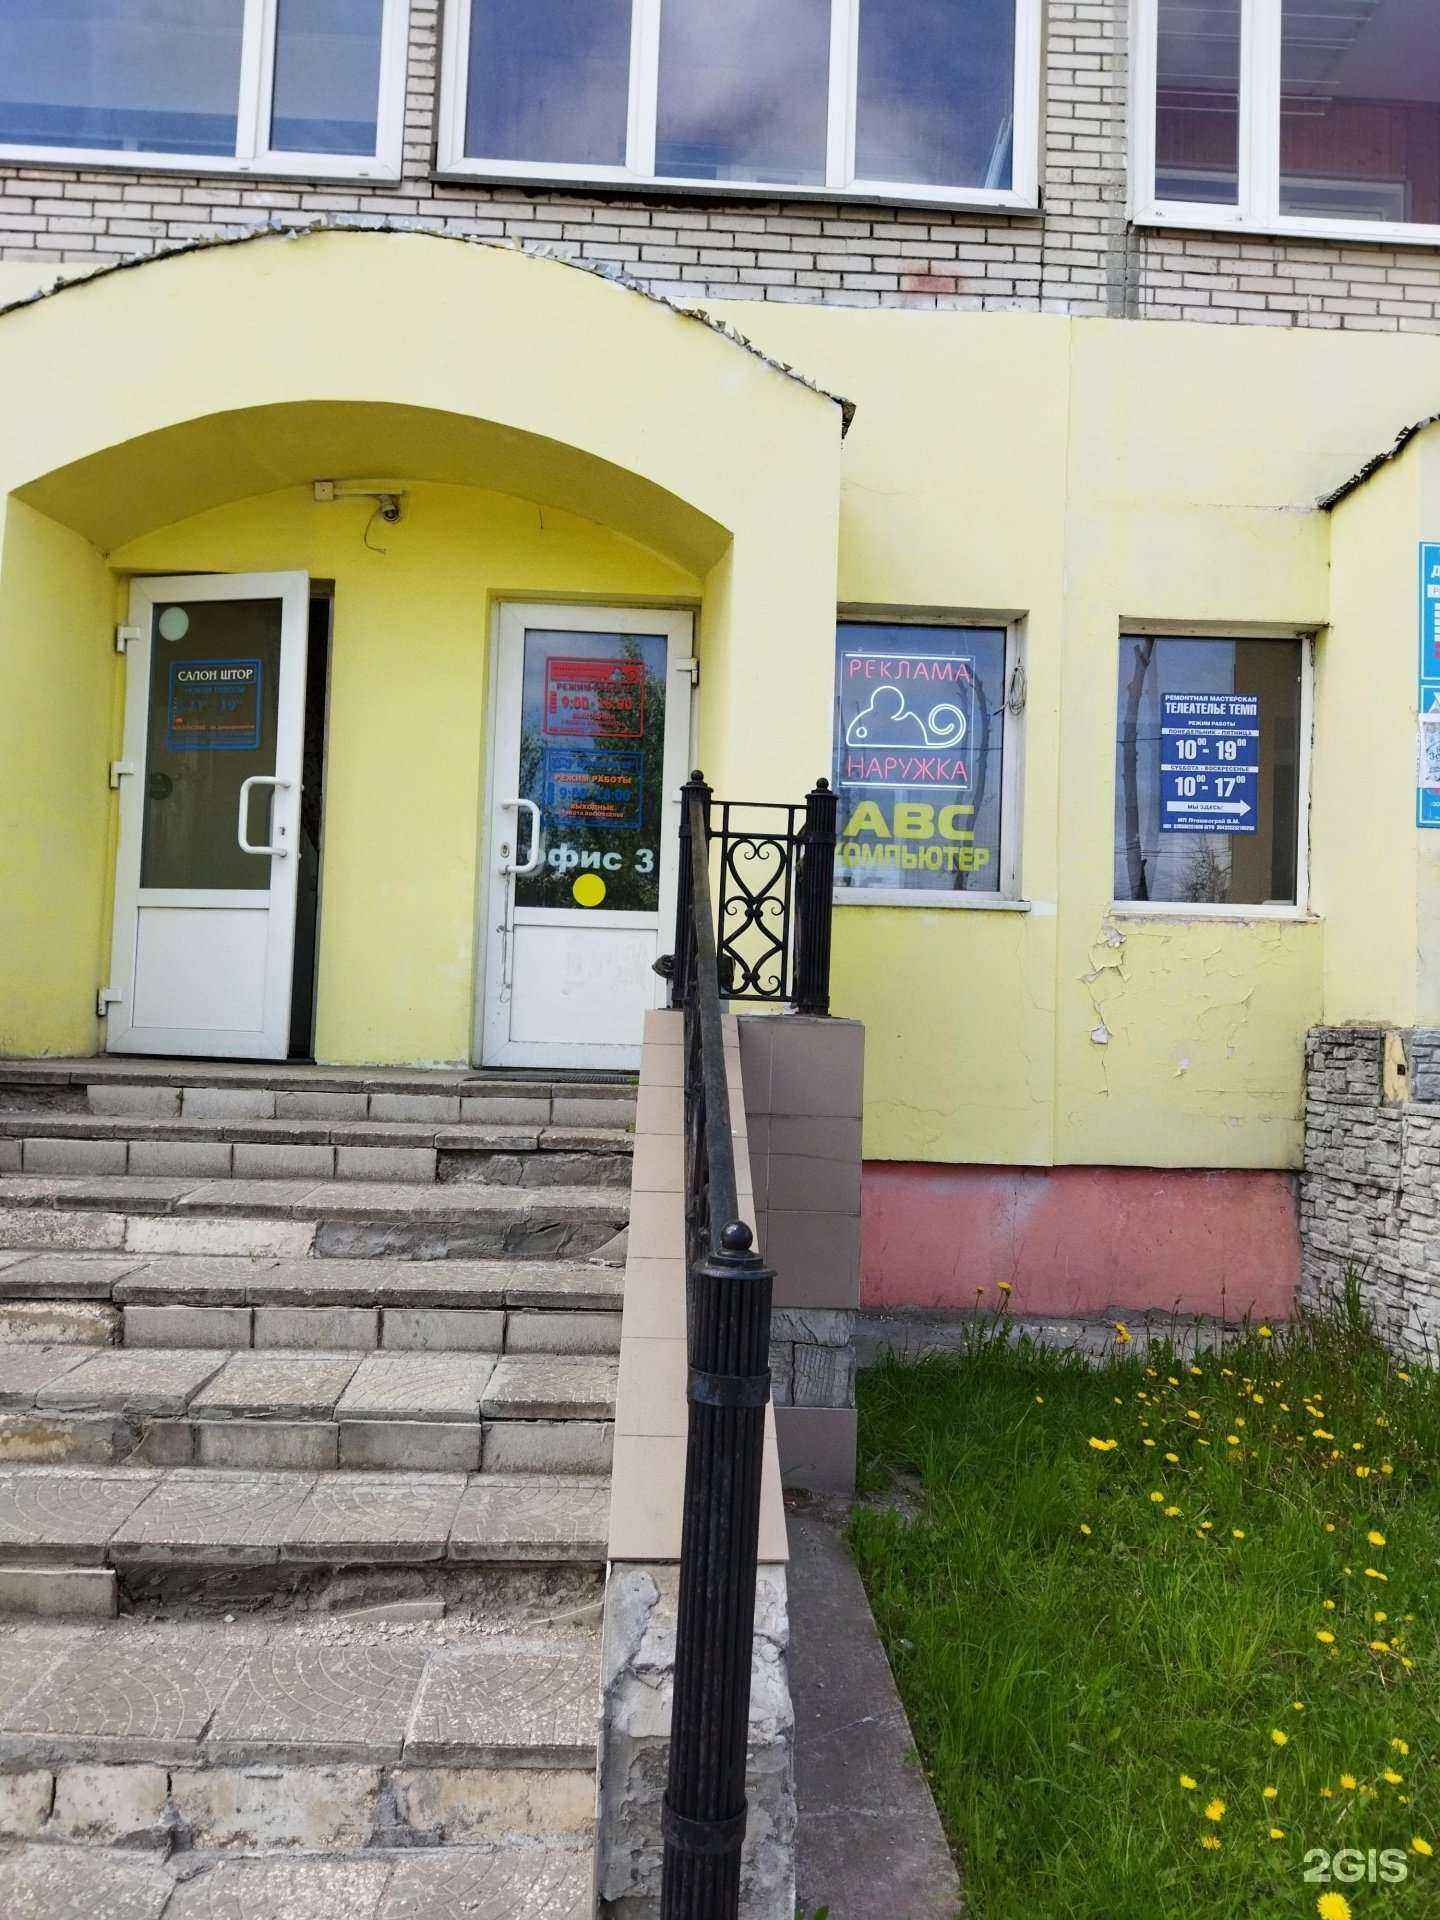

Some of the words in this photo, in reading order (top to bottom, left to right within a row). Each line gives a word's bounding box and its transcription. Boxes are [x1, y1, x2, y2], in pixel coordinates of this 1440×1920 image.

[178, 670, 217, 681] САЛОН
[220, 669, 253, 680] ШТОР
[849, 659, 972, 682] РЕКЛАМА
[1165, 694, 1208, 702] РЕМОНТНАЯ
[1209, 695, 1257, 703] МАСТЕРСКАЯ
[1165, 702, 1226, 715] ТЕЛЕАТЕЛЬЕ
[1229, 703, 1257, 716] ТЕМП
[847, 755, 968, 782] НАРУЖКА
[591, 774, 632, 784] РАБОТЫ
[634, 848, 654, 874] 3
